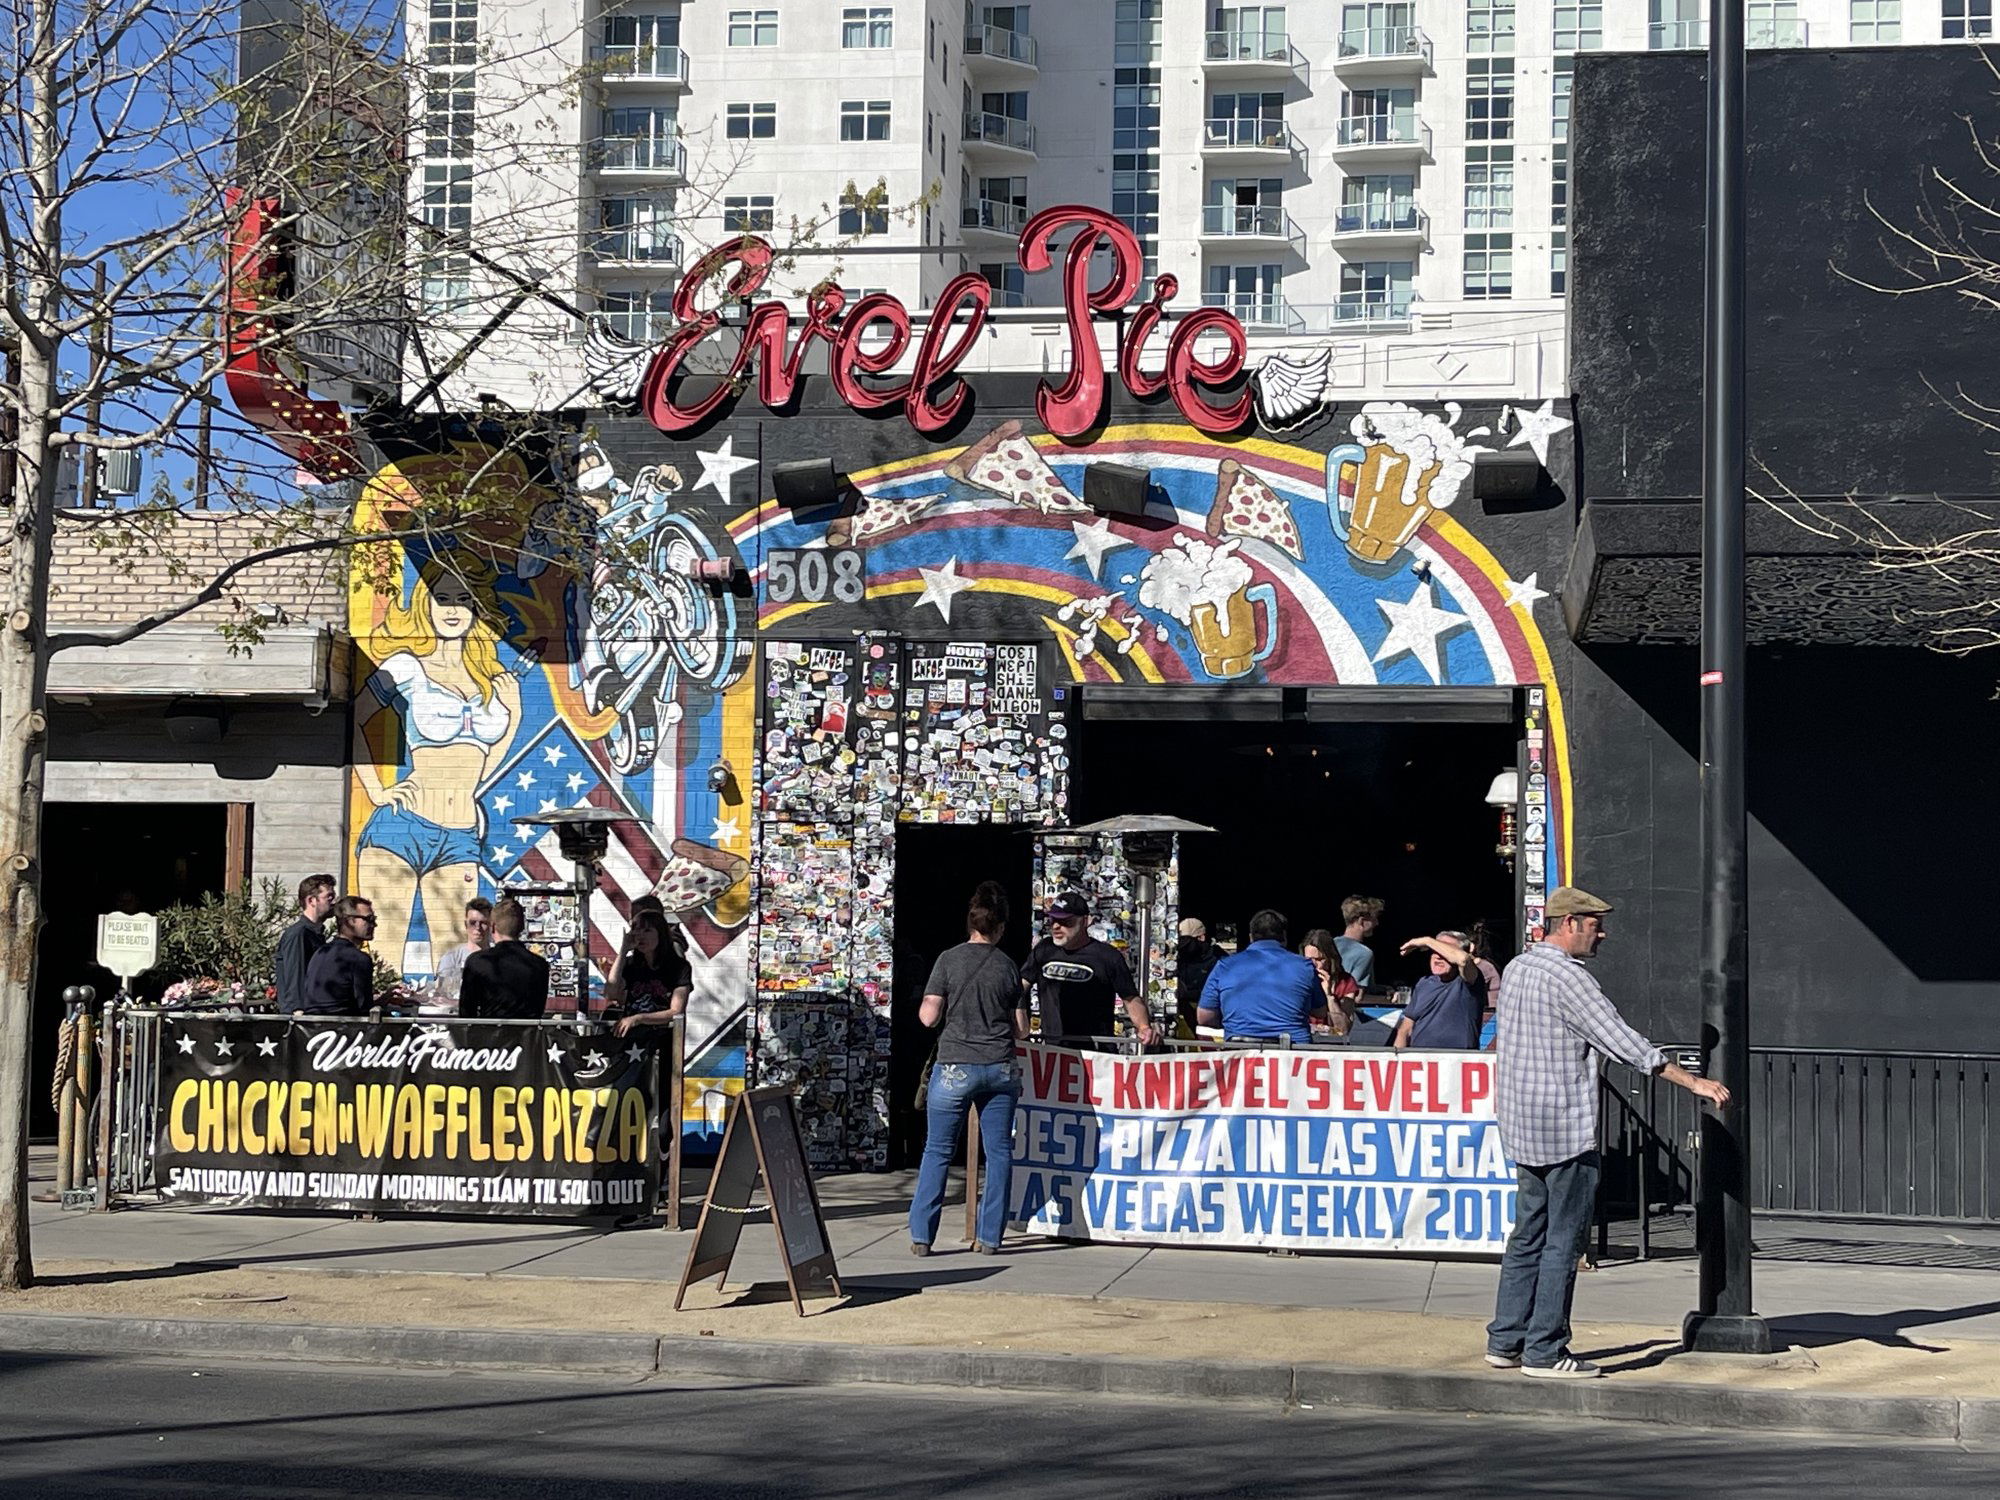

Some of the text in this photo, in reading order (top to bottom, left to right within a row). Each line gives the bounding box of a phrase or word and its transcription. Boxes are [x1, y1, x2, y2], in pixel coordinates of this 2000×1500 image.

[644, 204, 1253, 437] Evel Pie
[768, 550, 864, 603] 508
[107, 921, 149, 932] PLEASE WAIT
[107, 934, 150, 945] TO BE SEATED
[306, 1030, 523, 1073] World Famous
[1113, 1057, 1331, 1111] KNIEVEL'S
[1342, 1059, 1450, 1113] EVEL
[1461, 1062, 1497, 1114] P
[169, 1078, 338, 1156] CHICKEN
[355, 1083, 535, 1162] WAFFLES
[543, 1086, 647, 1164] PIZZA
[1110, 1118, 1236, 1172] PIZZA
[1245, 1119, 1286, 1173] IN
[1297, 1120, 1378, 1177] LAS
[1386, 1122, 1517, 1179] VEGA
[169, 1167, 645, 1205] SATURDAY AND SUNDAY MORNINGS 11AM TIL SOLD OUT
[1009, 1171, 1073, 1226] AS
[1085, 1178, 1225, 1233] VEGAS
[1236, 1182, 1415, 1239] WEEKLY
